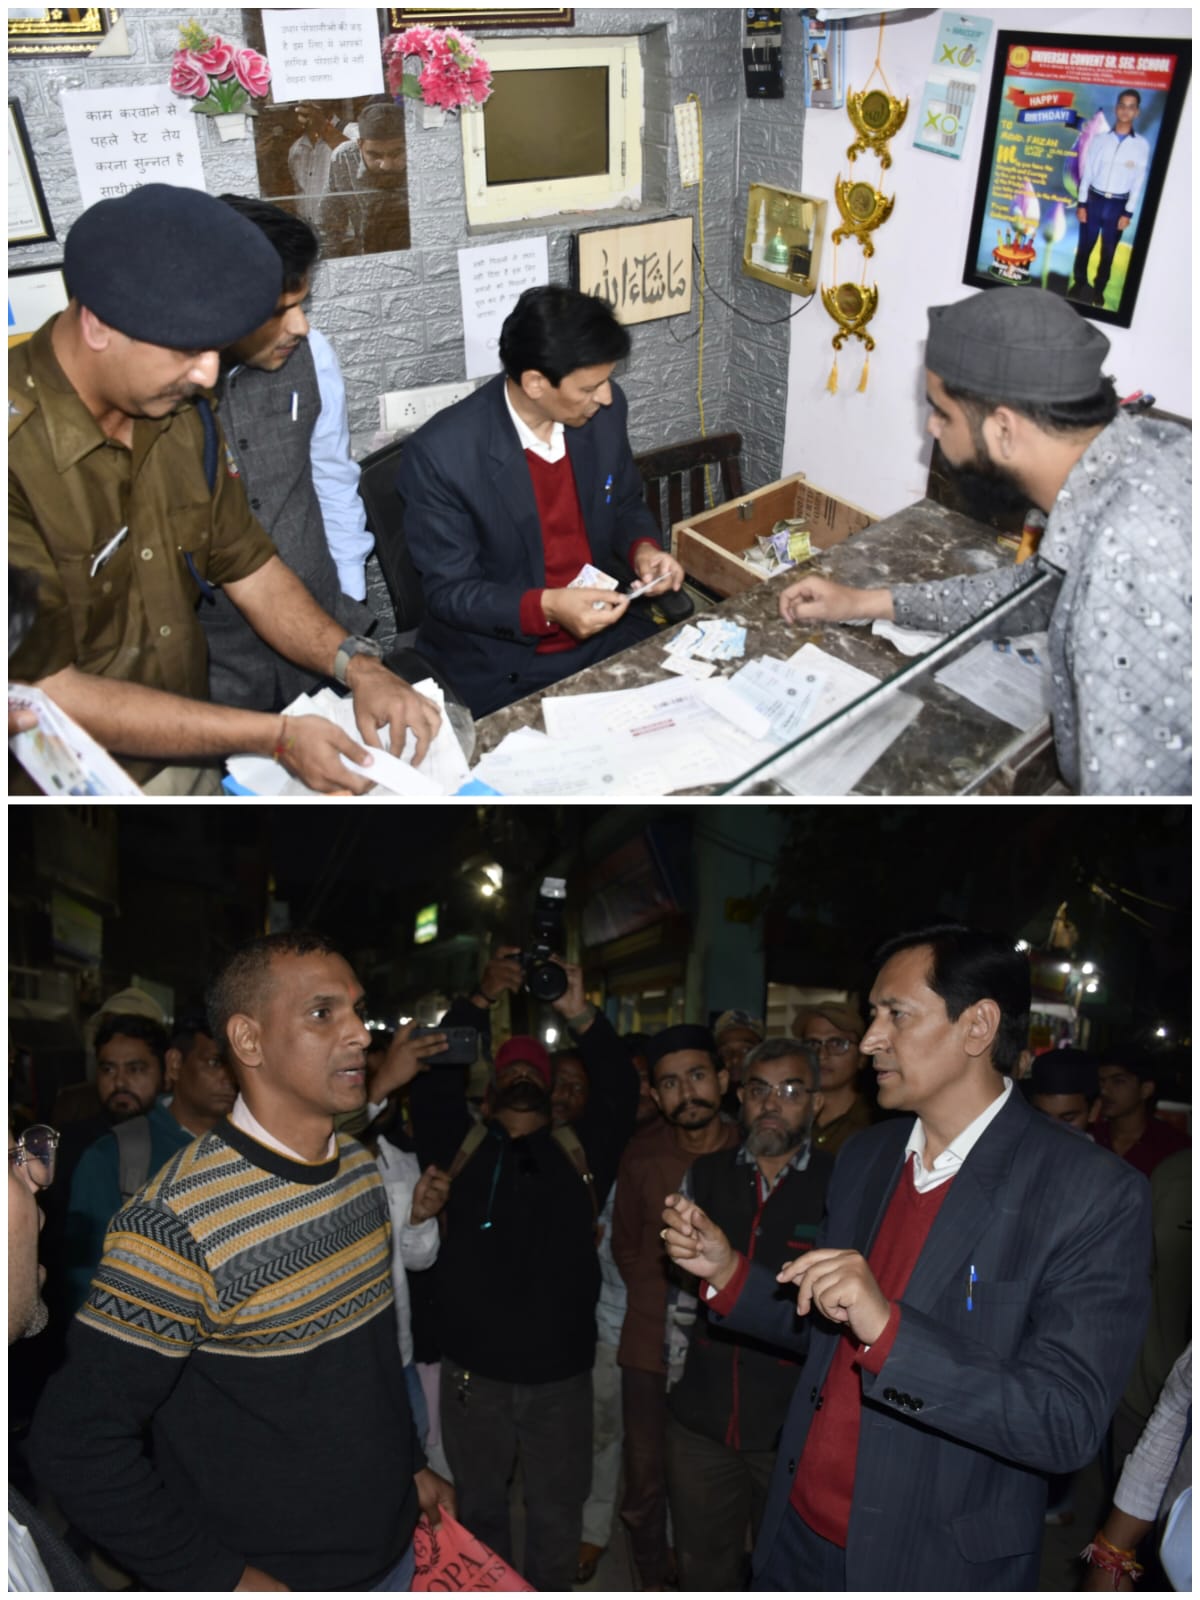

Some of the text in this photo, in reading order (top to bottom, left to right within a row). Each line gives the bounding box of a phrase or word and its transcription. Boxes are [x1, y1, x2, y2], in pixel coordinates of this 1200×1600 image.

[1031, 50, 1069, 65] UNIVERSAL
[1070, 52, 1104, 67] CONVENT
[1137, 57, 1170, 72] SCHOOL
[1029, 94, 1060, 106] HAPPY
[85, 103, 176, 121] काम करवाने से
[1024, 109, 1070, 122] BIRTHDAY!
[90, 133, 119, 148] पहले
[131, 130, 149, 144] रेट
[95, 152, 185, 174] करना सुन्नत है
